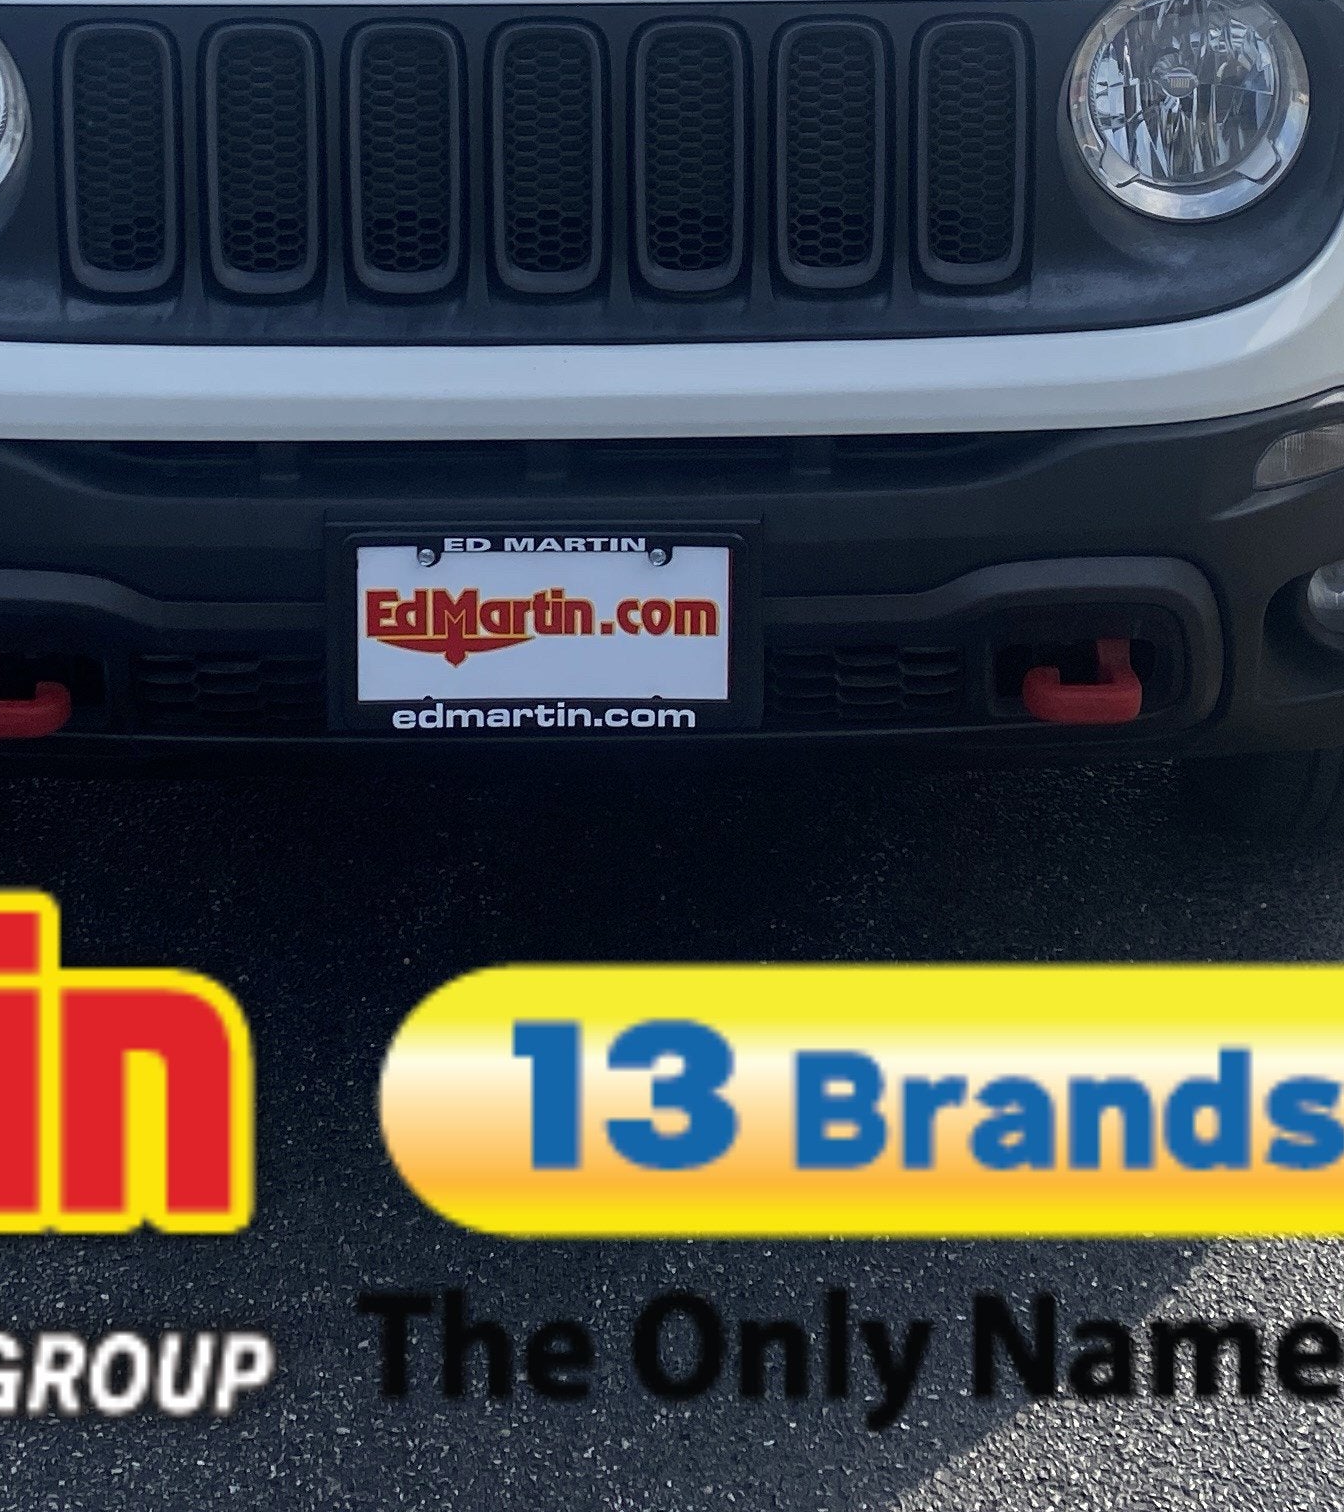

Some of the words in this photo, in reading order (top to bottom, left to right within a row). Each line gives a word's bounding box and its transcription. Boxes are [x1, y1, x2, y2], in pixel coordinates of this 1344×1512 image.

[443, 537, 492, 553] ED
[503, 537, 647, 553] MARTIN
[391, 701, 697, 730] edmartin.com
